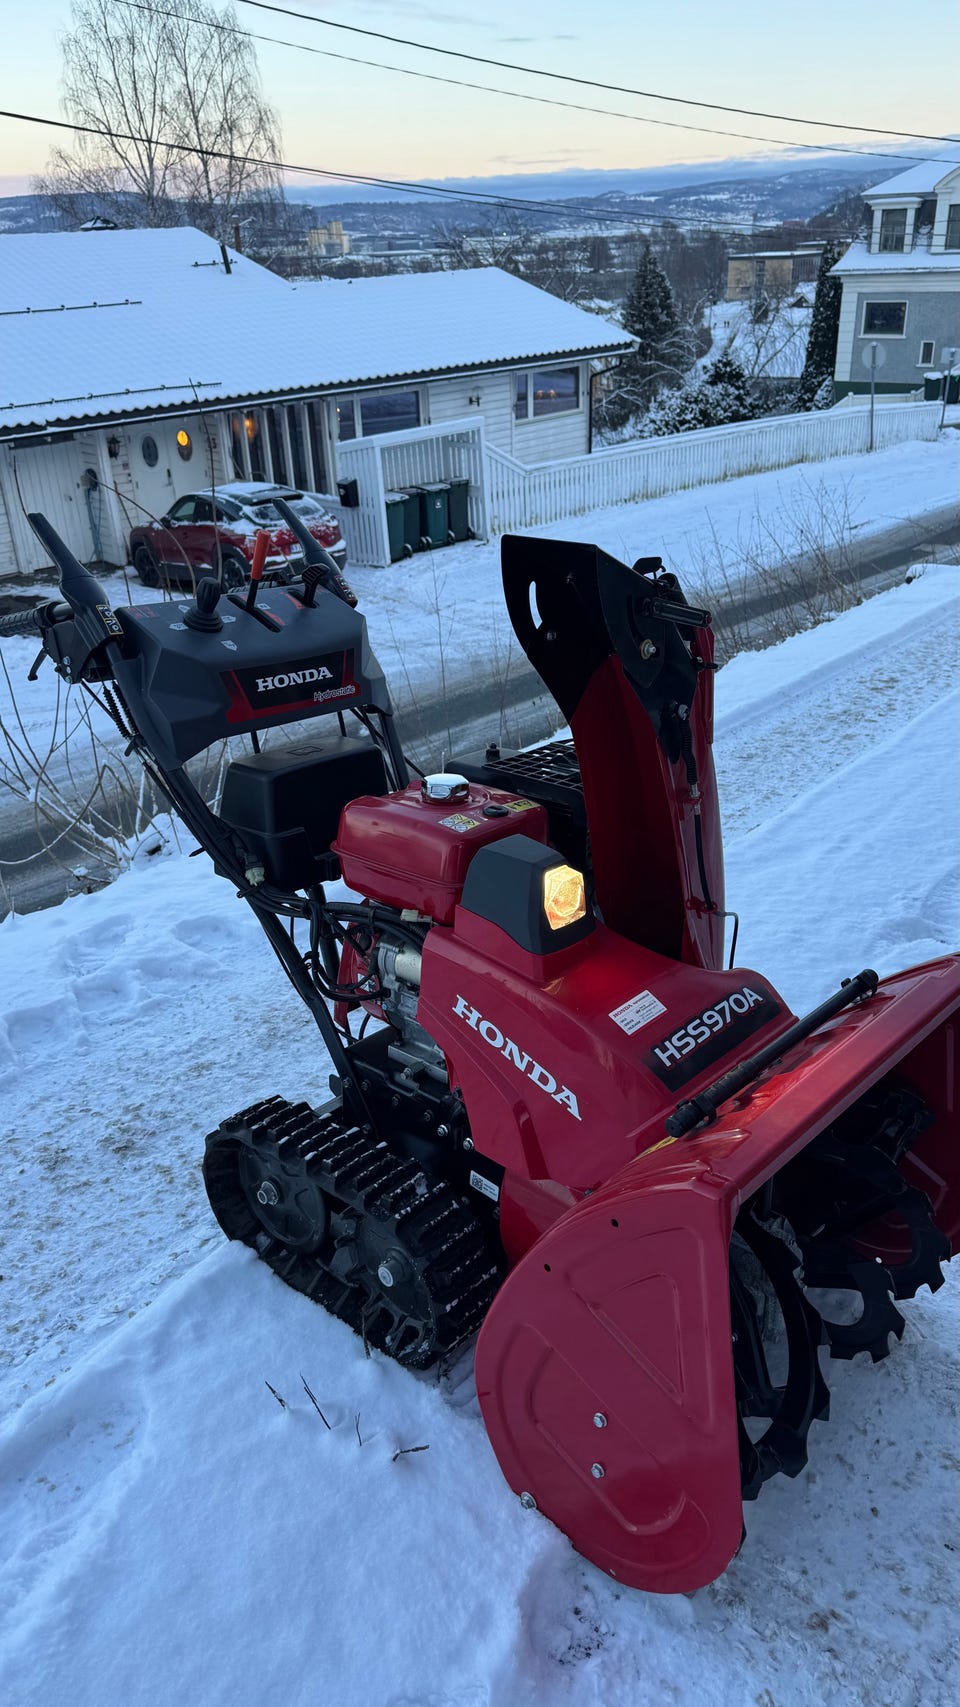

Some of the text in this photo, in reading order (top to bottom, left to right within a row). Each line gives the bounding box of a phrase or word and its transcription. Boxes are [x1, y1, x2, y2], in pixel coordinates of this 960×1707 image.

[256, 666, 333, 692] HONDA
[313, 685, 356, 702] Hydrostatic
[654, 987, 764, 1067] HSS970A
[452, 994, 582, 1121] HONDA
